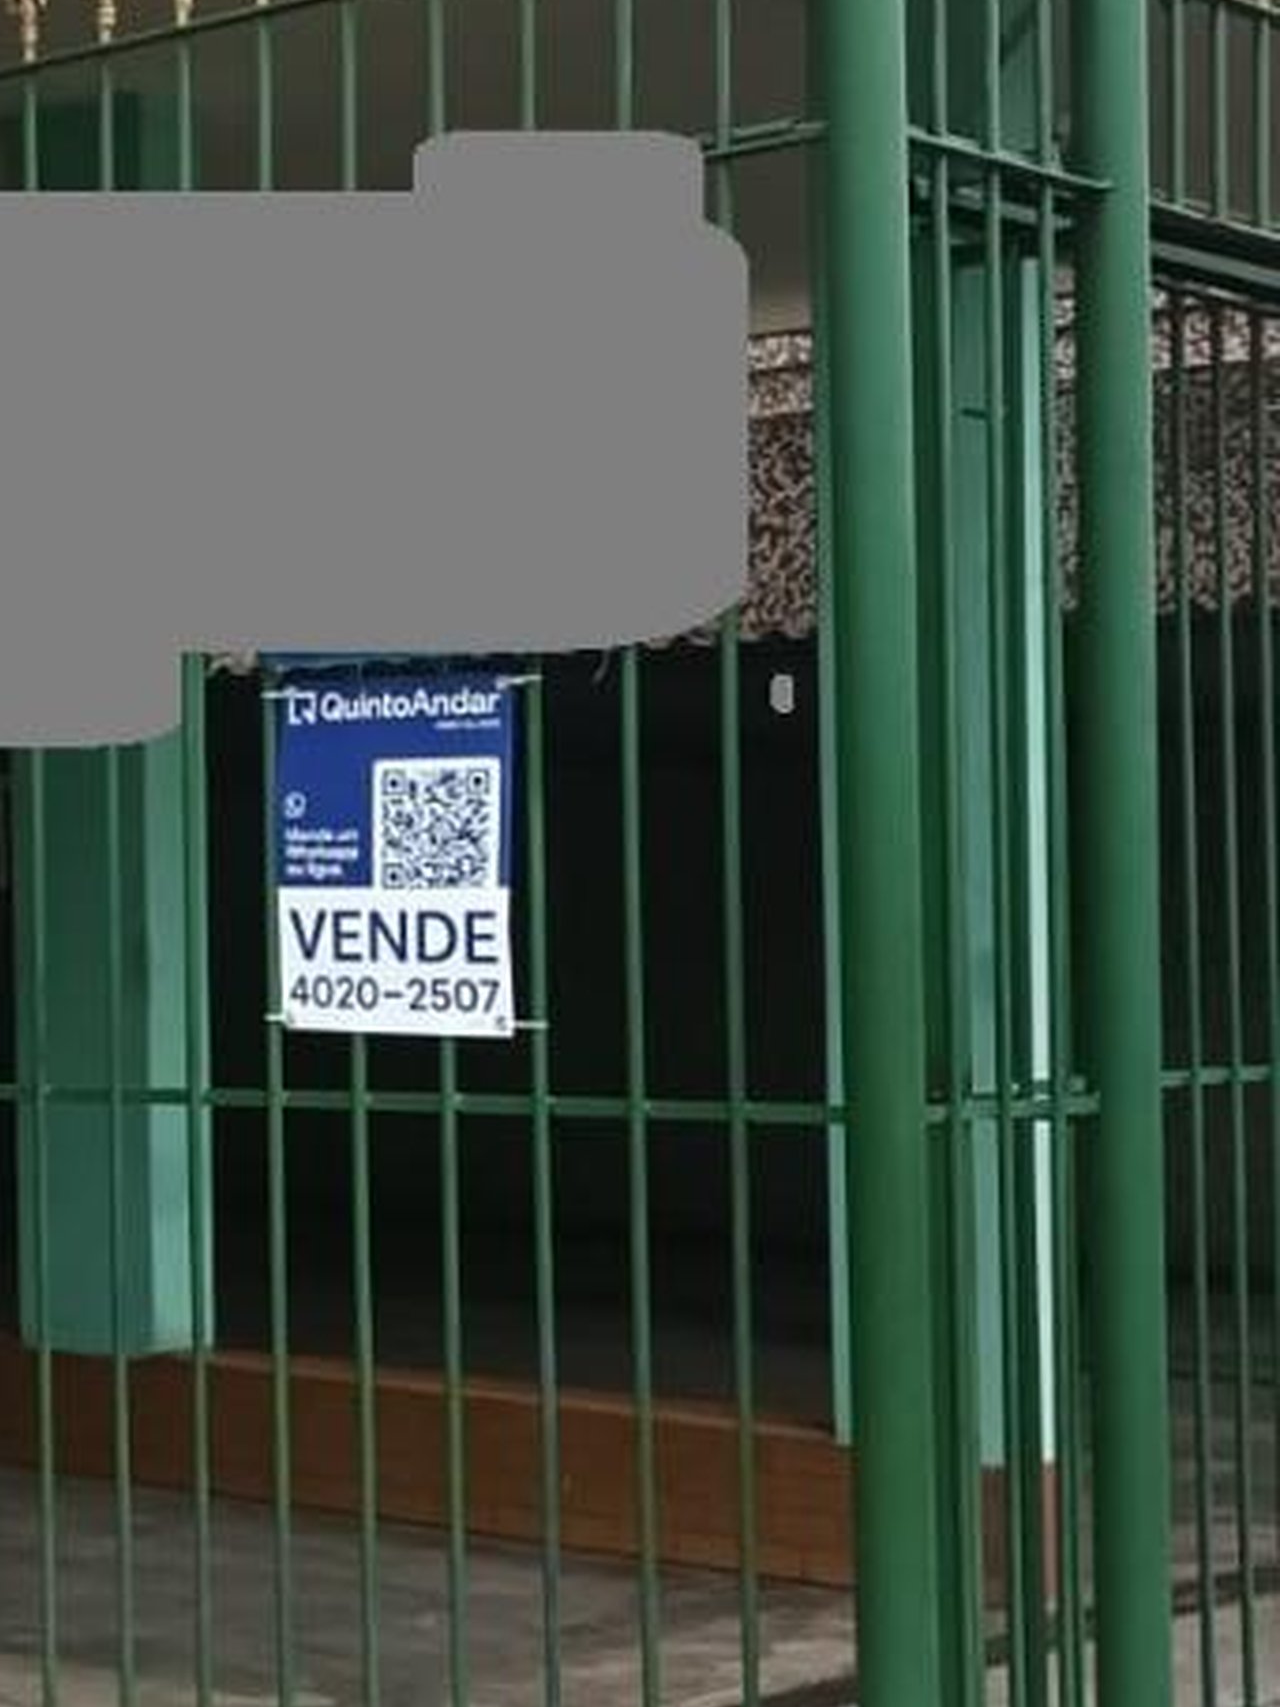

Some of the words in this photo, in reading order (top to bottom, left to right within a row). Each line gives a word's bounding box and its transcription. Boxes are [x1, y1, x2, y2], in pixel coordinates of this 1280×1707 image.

[320, 688, 501, 722] QuintoAndar
[289, 908, 500, 964] VENDE
[288, 975, 501, 1013] 4020-2507
